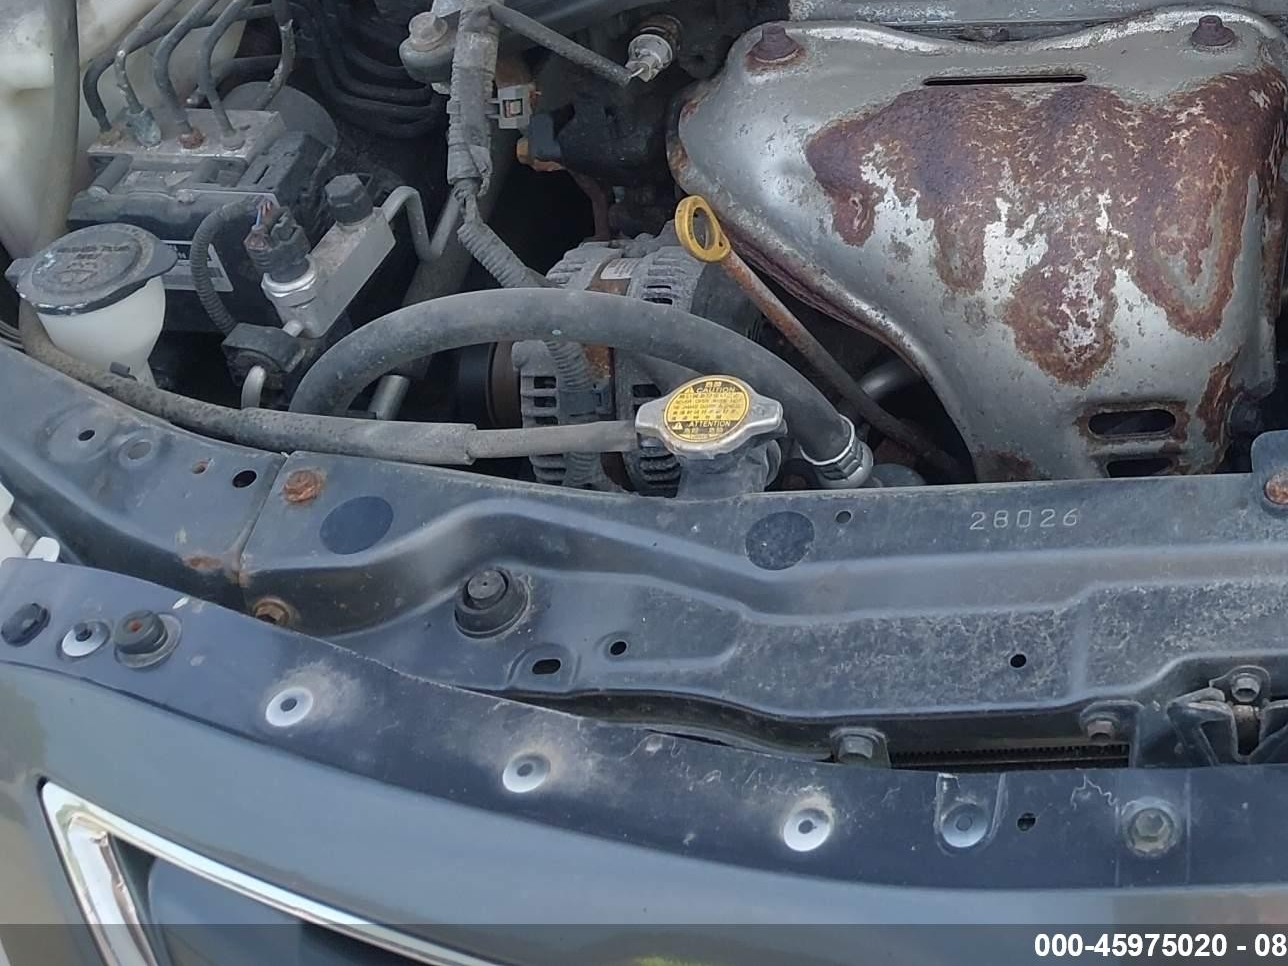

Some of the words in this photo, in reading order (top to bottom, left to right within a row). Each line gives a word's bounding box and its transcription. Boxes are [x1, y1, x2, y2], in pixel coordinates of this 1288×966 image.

[696, 386, 736, 394] CAUTION
[687, 420, 732, 428] ATTENTION
[968, 507, 1078, 531] 28026
